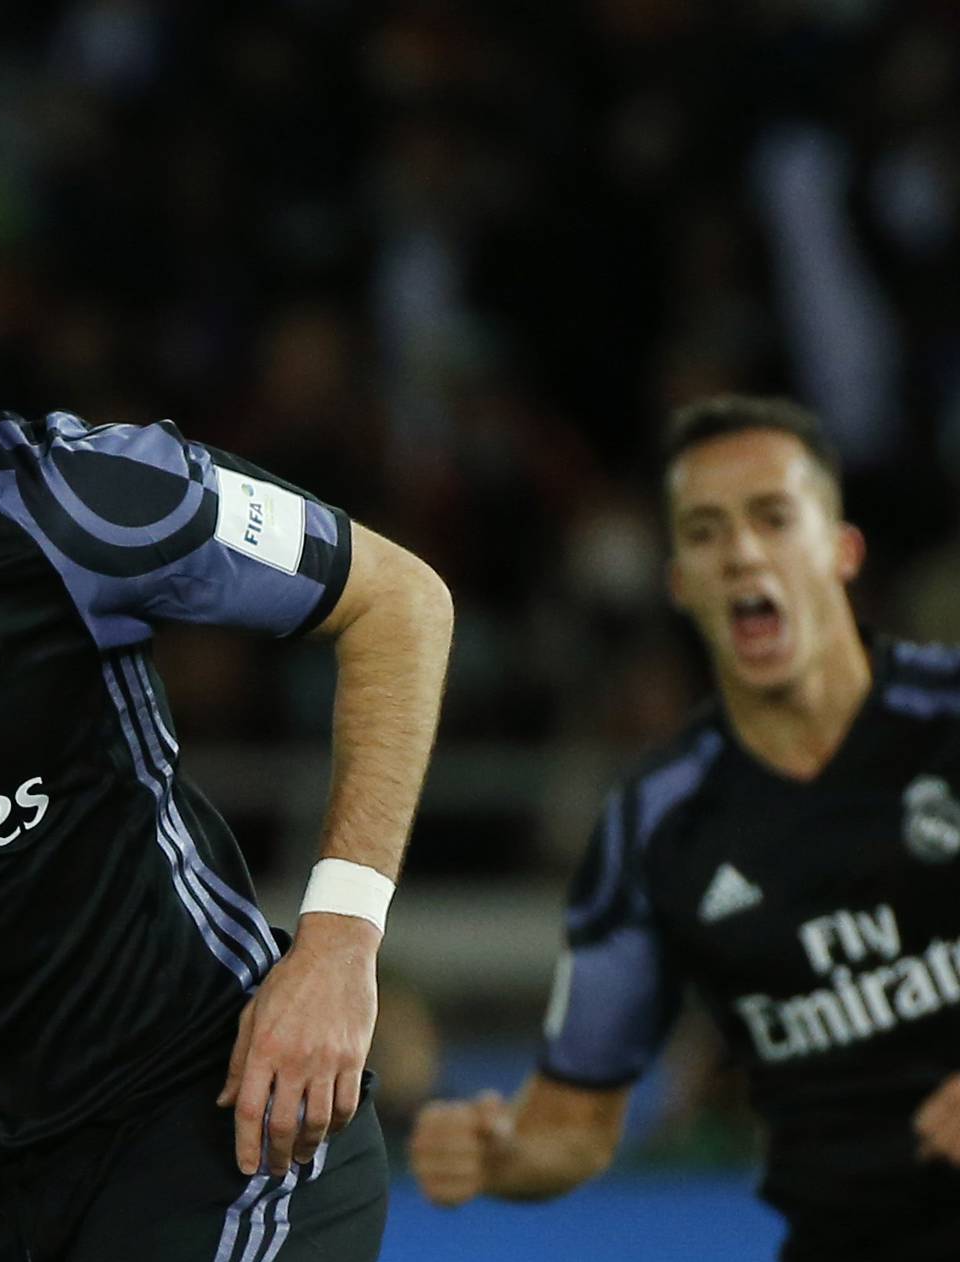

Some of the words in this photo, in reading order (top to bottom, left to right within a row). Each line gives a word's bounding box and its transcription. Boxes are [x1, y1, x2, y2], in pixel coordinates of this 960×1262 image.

[243, 502, 262, 546] FIFA
[798, 904, 900, 975] Fly
[737, 935, 960, 1060] Emirat
